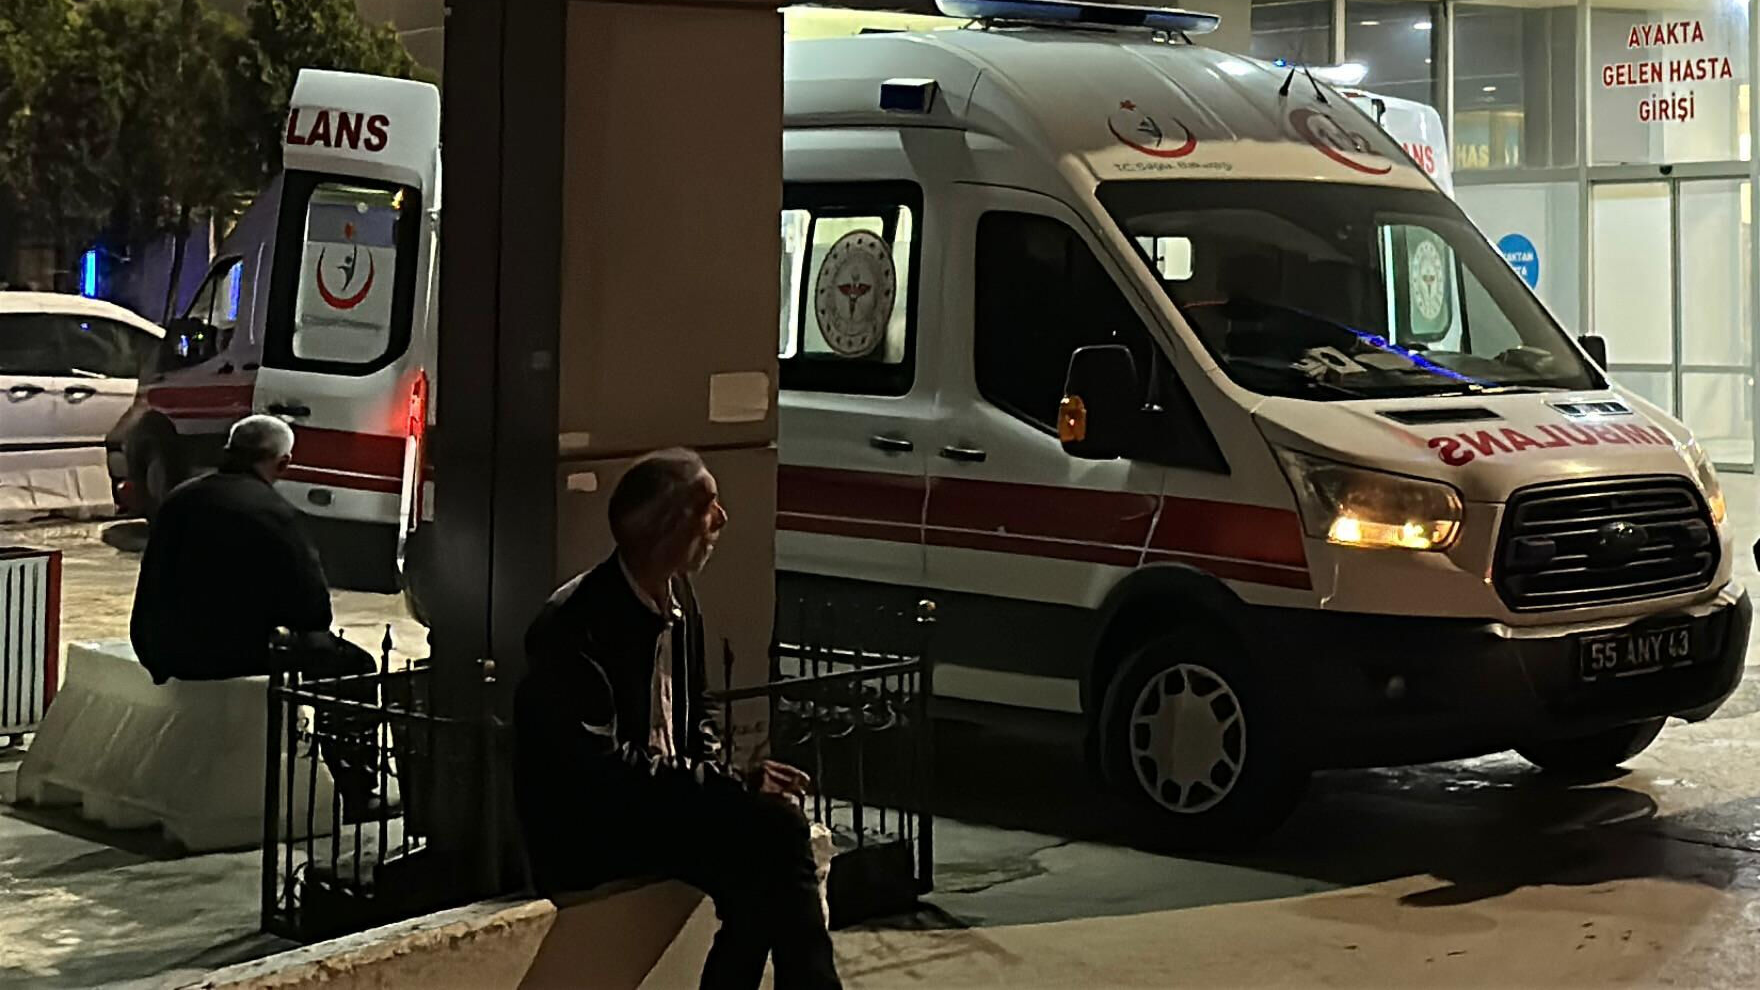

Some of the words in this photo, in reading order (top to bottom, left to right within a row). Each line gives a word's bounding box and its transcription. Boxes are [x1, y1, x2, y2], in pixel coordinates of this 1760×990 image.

[1628, 20, 1704, 48] AYAKTA
[1602, 61, 1663, 86] GELEN
[1669, 56, 1733, 82] HASTA
[1639, 90, 1695, 122] GİRİŞİ
[286, 108, 390, 152] LANS
[1591, 642, 1617, 671] 55
